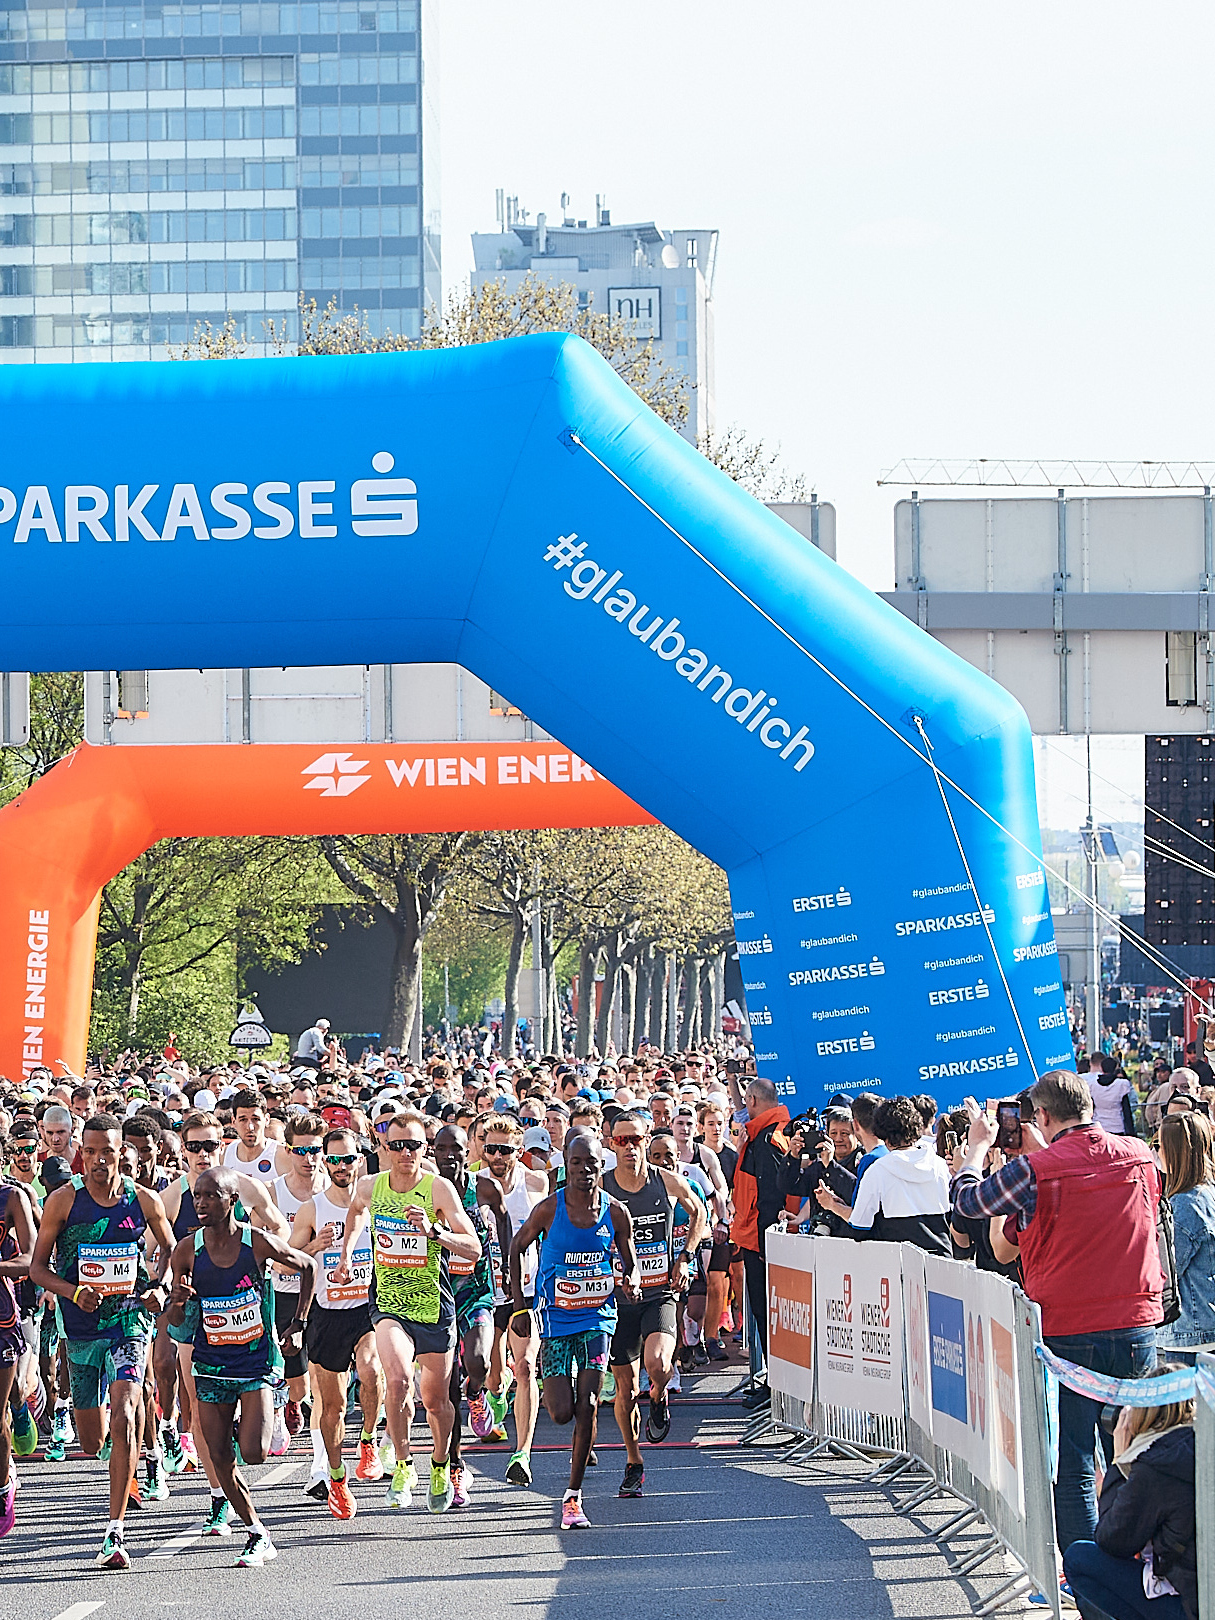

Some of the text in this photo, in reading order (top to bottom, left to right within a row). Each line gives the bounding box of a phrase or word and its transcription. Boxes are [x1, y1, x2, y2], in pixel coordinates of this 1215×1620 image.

[616, 298, 652, 318] nH
[542, 532, 816, 772] #glaubandich
[385, 756, 486, 788] WIEN
[1016, 872, 1039, 889] ERSTE
[912, 881, 973, 899] #glaubandich
[793, 893, 835, 912] ERSTE
[895, 911, 982, 936] SPARKASSE
[800, 933, 858, 949] #glaubandich
[24, 909, 50, 1019] ENERGIE
[924, 953, 984, 971] #glaubandich
[788, 963, 868, 986] SPARKASSE
[928, 986, 975, 1006] ERSTE
[812, 1005, 870, 1021] #glaubandich
[1038, 1013, 1060, 1031] ERSTE
[935, 1025, 996, 1042] #glaubandich
[817, 1038, 858, 1056] ERSTE
[918, 1054, 1005, 1080] SPARKASSE
[824, 1077, 882, 1093] #glaubandich
[376, 1219, 415, 1231] SPARKASSE
[80, 1248, 127, 1257] SPARKASSE
[401, 1238, 418, 1250] M2
[114, 1263, 130, 1276] M4
[566, 1269, 593, 1278] ERSTE
[642, 1259, 664, 1271] M22
[586, 1281, 608, 1292] M31
[202, 1298, 246, 1309] SPARKASSE
[825, 1298, 845, 1323] WIENER
[231, 1309, 255, 1326] M40
[860, 1302, 882, 1328] WIENER
[237, 1328, 262, 1341] ENERGIE
